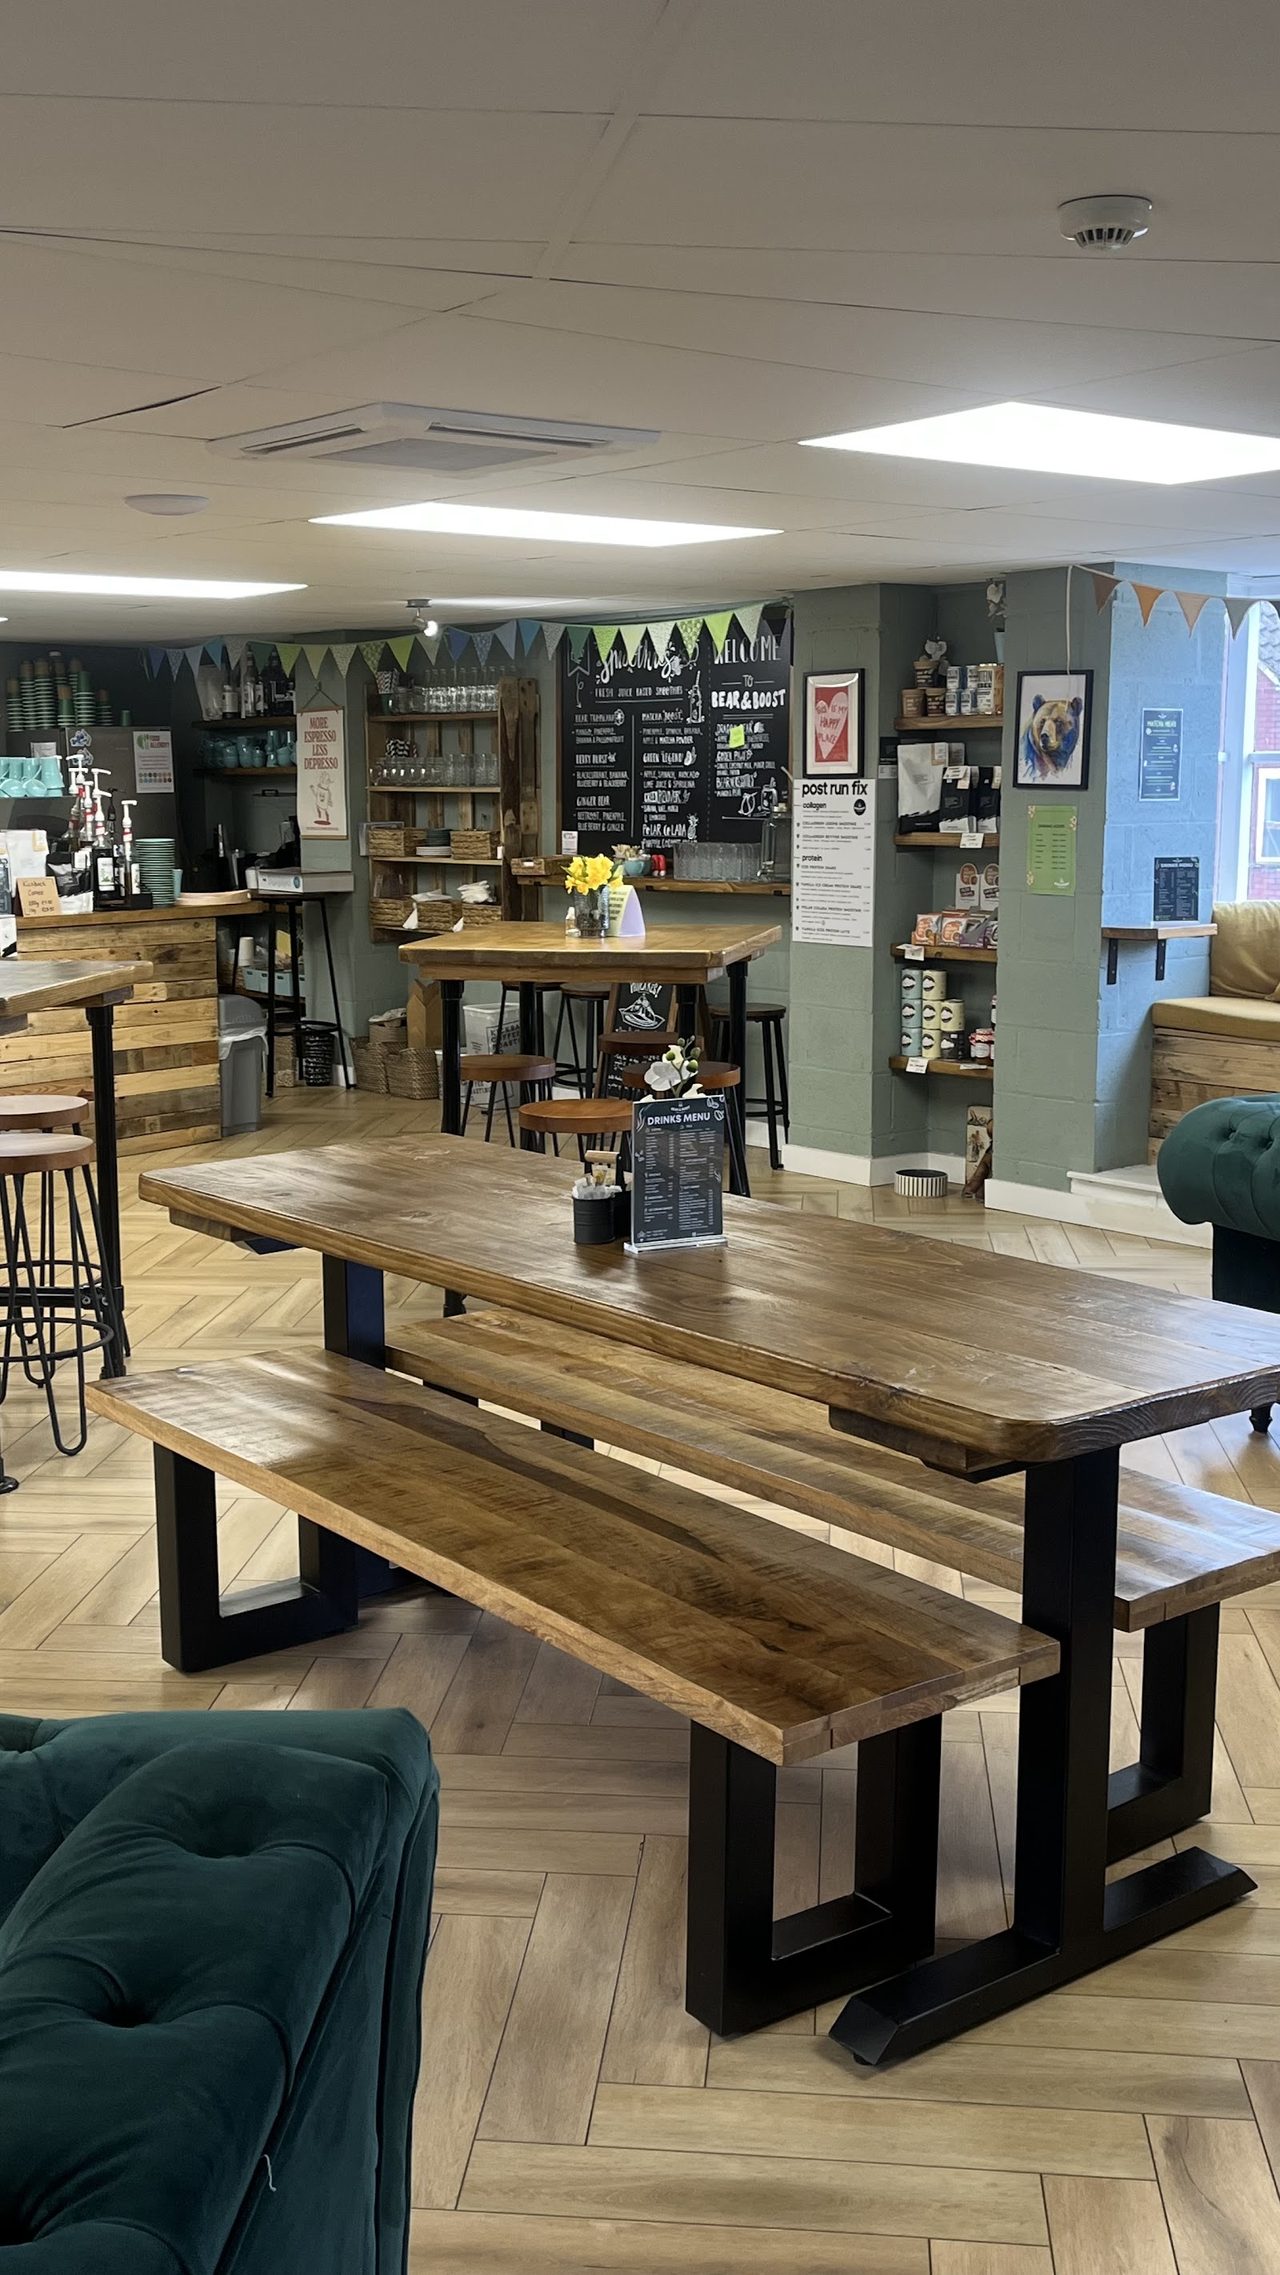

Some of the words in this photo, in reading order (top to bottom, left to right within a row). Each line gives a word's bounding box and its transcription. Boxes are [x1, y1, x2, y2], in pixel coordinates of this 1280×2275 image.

[742, 674, 753, 687] TO
[309, 717, 328, 729] MORE
[820, 716, 841, 729] HAPPY
[304, 730, 337, 743] ESPRESSO
[818, 733, 837, 744] PLACE
[312, 744, 328, 756] LESS
[304, 757, 339, 770] DEPRESSO
[802, 782, 828, 798] post
[830, 784, 849, 796] run
[852, 780, 868, 796] fix
[803, 802, 827, 810] collagen
[647, 1115, 681, 1126] DRINKS
[683, 1112, 711, 1123] MENU
